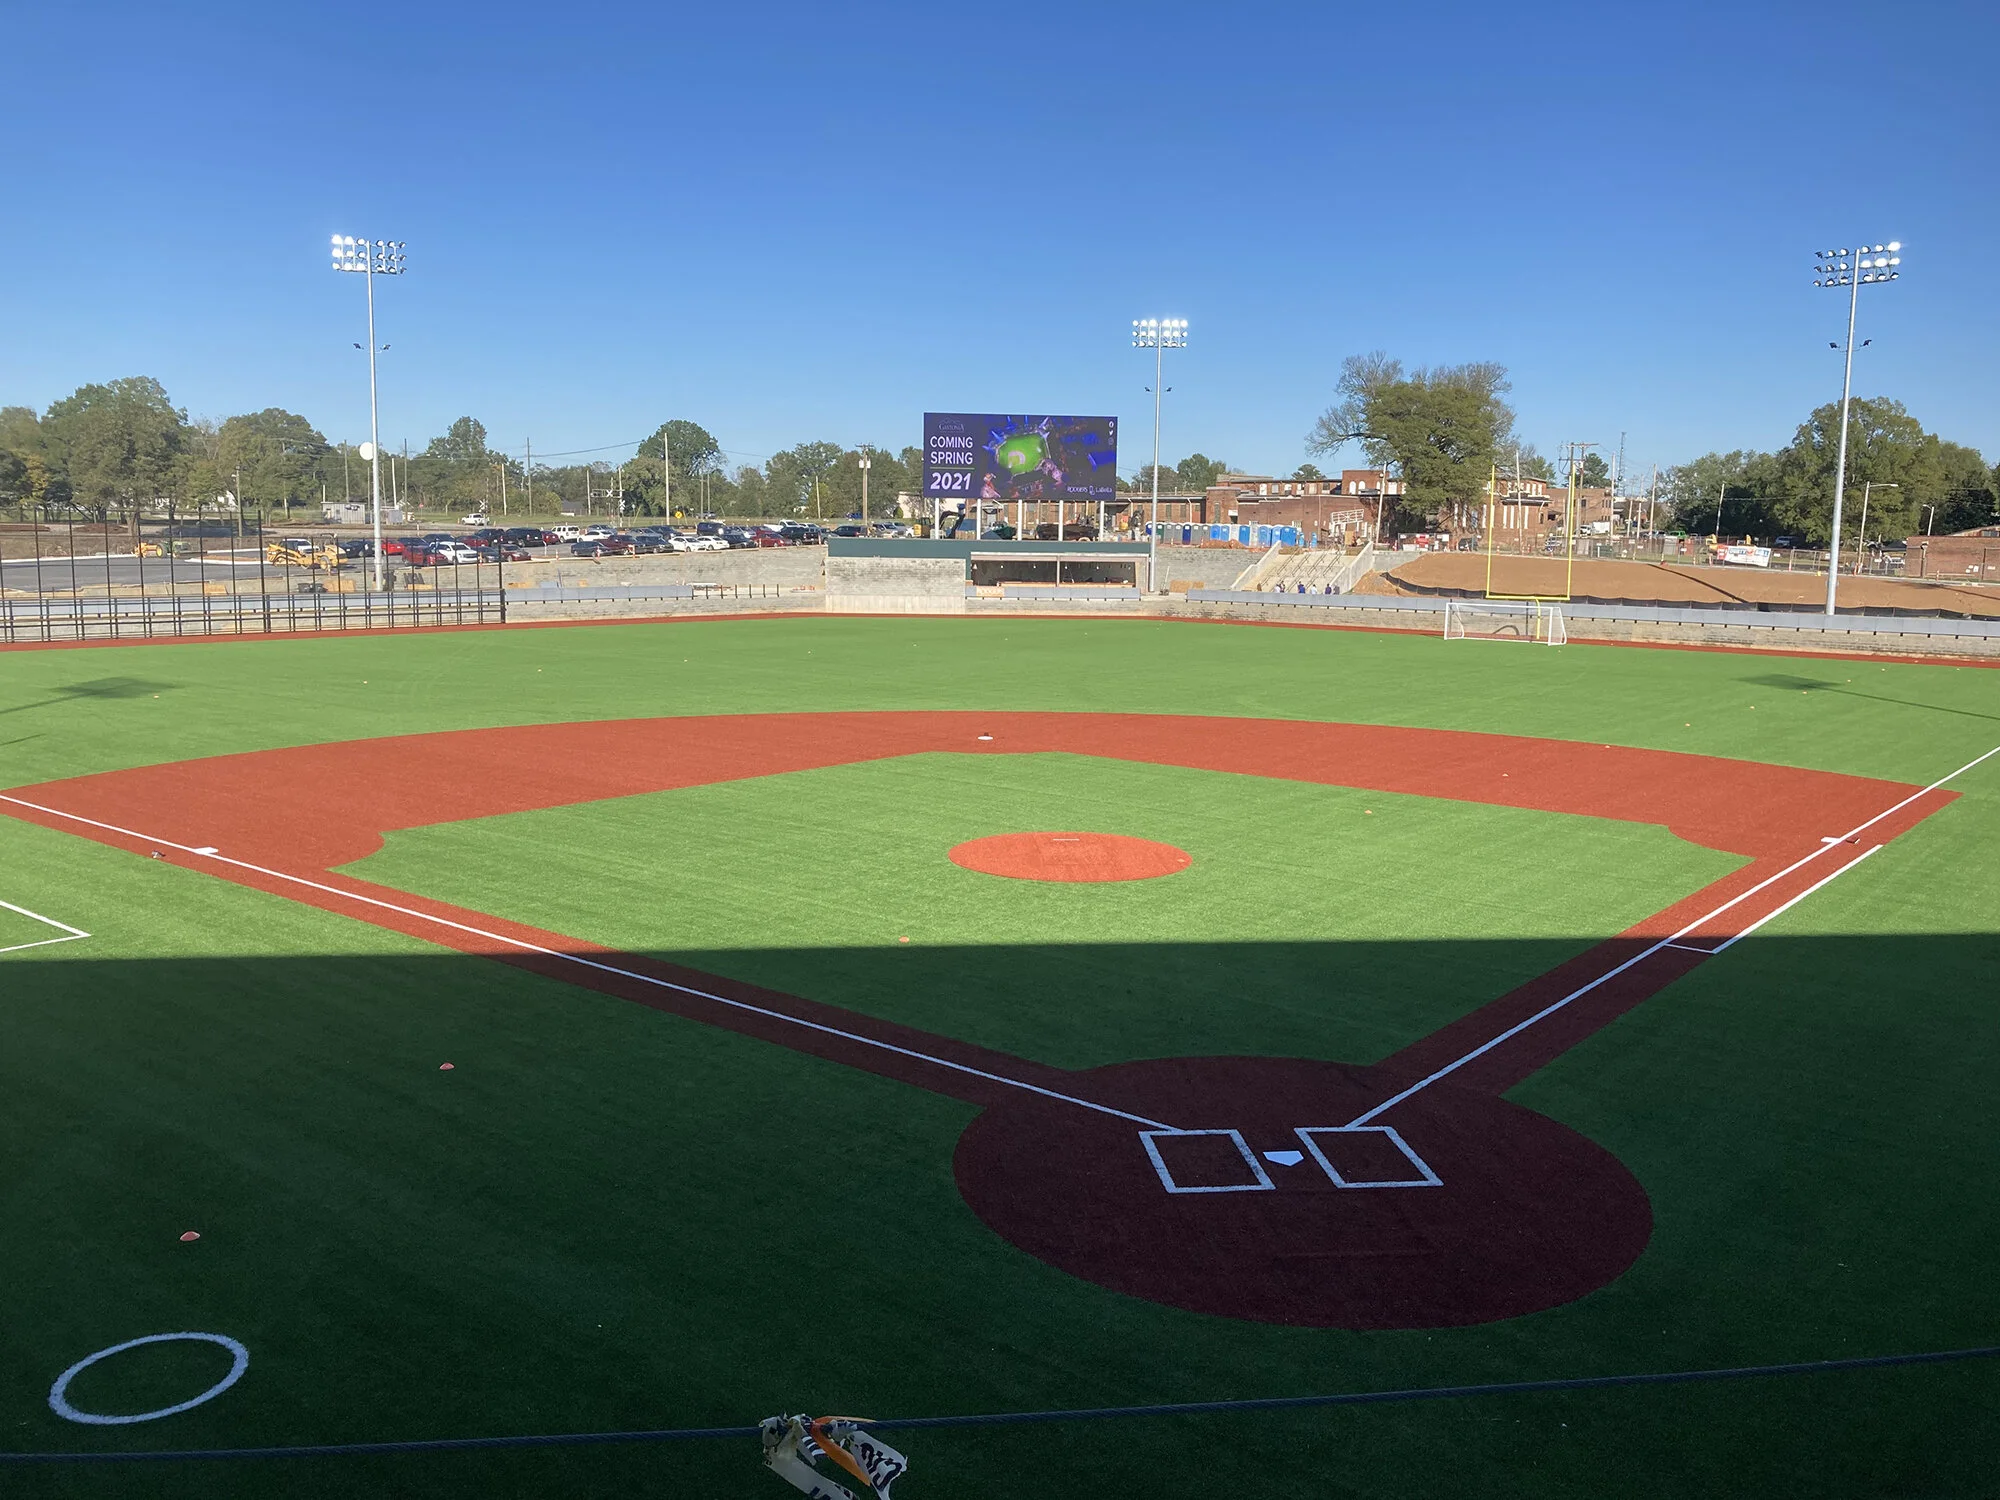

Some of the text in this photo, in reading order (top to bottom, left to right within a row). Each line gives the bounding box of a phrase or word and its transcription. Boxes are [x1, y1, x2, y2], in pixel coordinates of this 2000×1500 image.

[930, 435, 973, 449] COMING
[930, 451, 973, 465] SPRING
[930, 472, 971, 490] 2021
